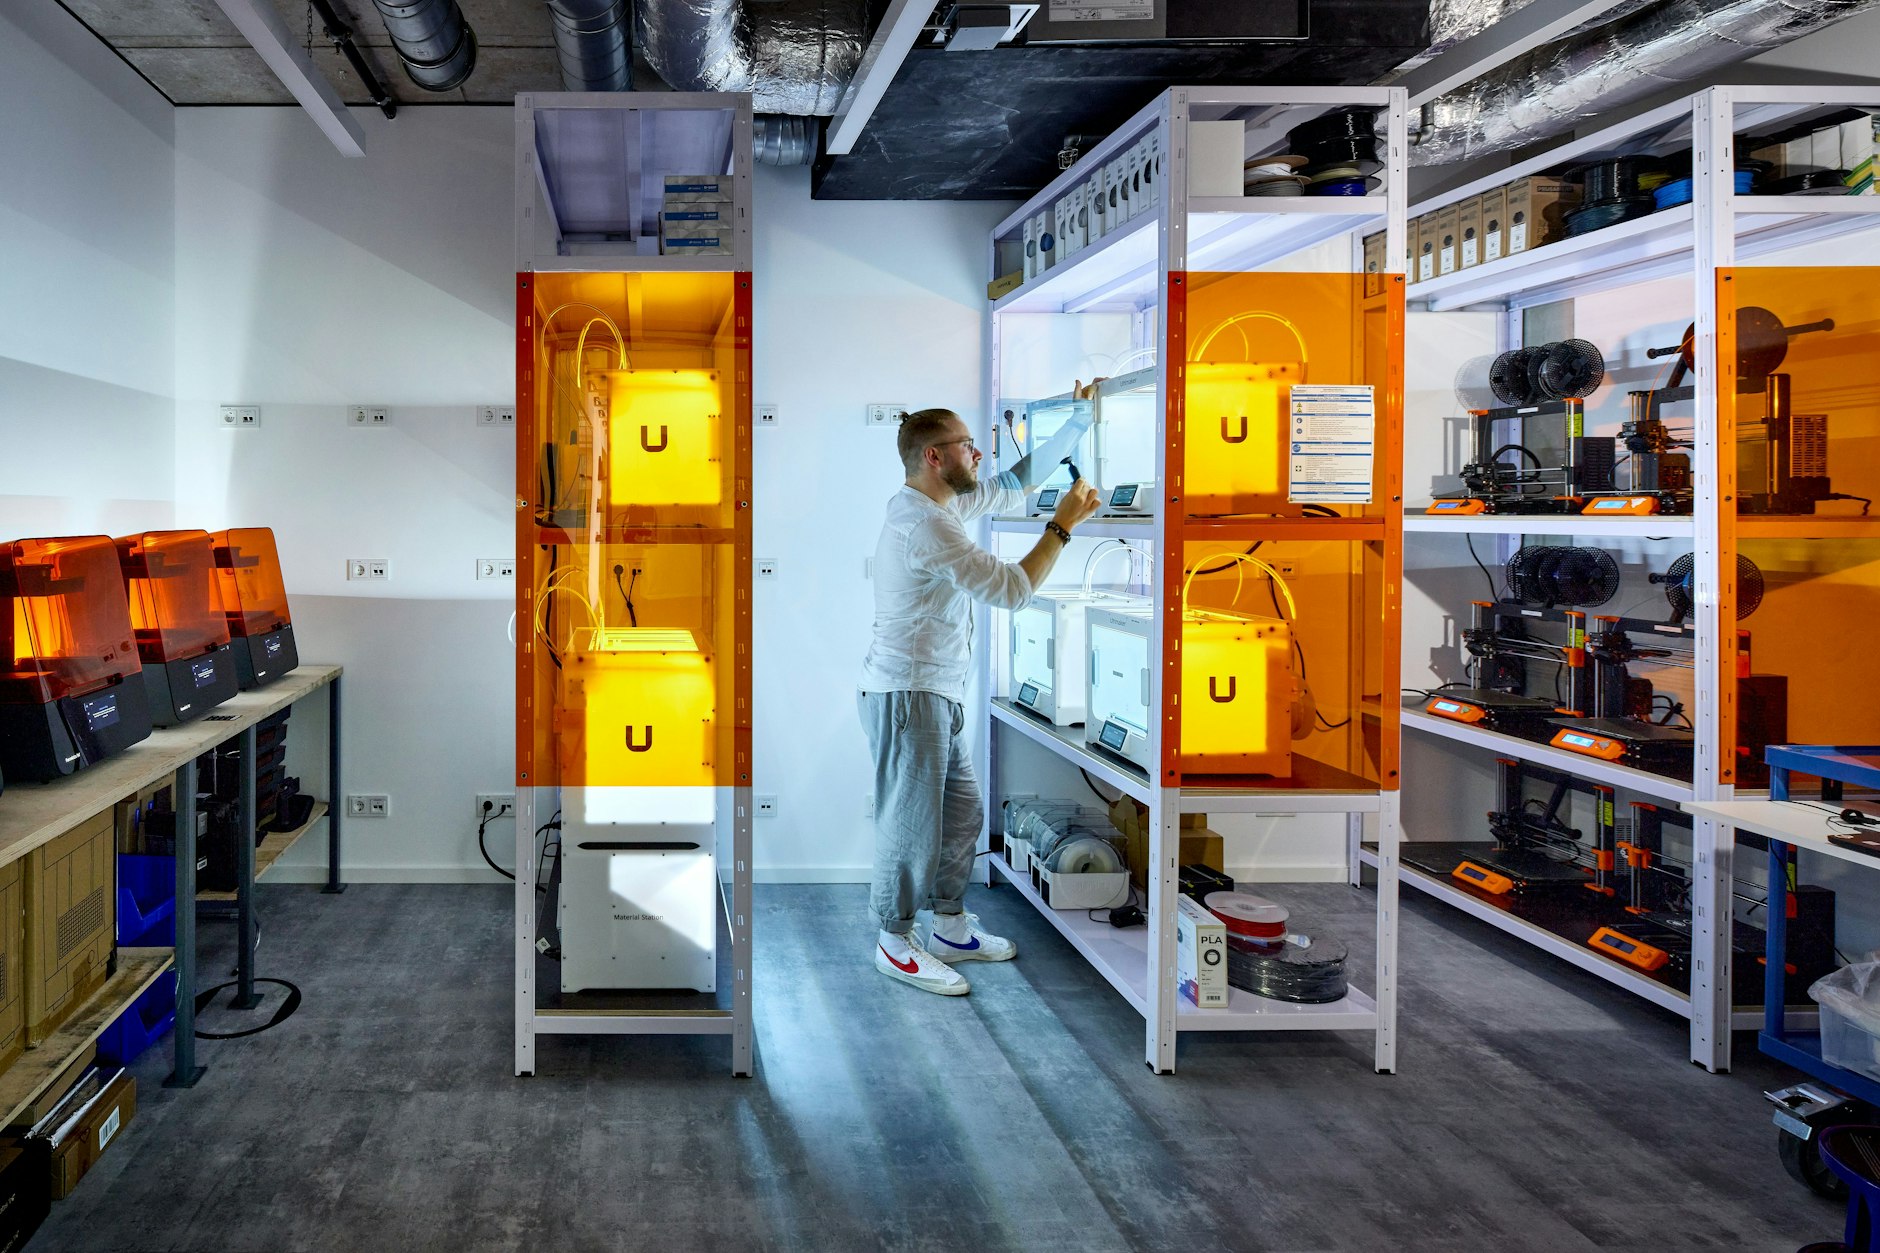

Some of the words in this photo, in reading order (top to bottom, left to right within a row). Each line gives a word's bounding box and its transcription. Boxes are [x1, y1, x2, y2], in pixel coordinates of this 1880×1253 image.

[641, 425, 667, 452] U
[1222, 416, 1247, 443] U
[1209, 677, 1235, 703] U
[626, 725, 652, 752] U
[1201, 936, 1223, 944] PLA
